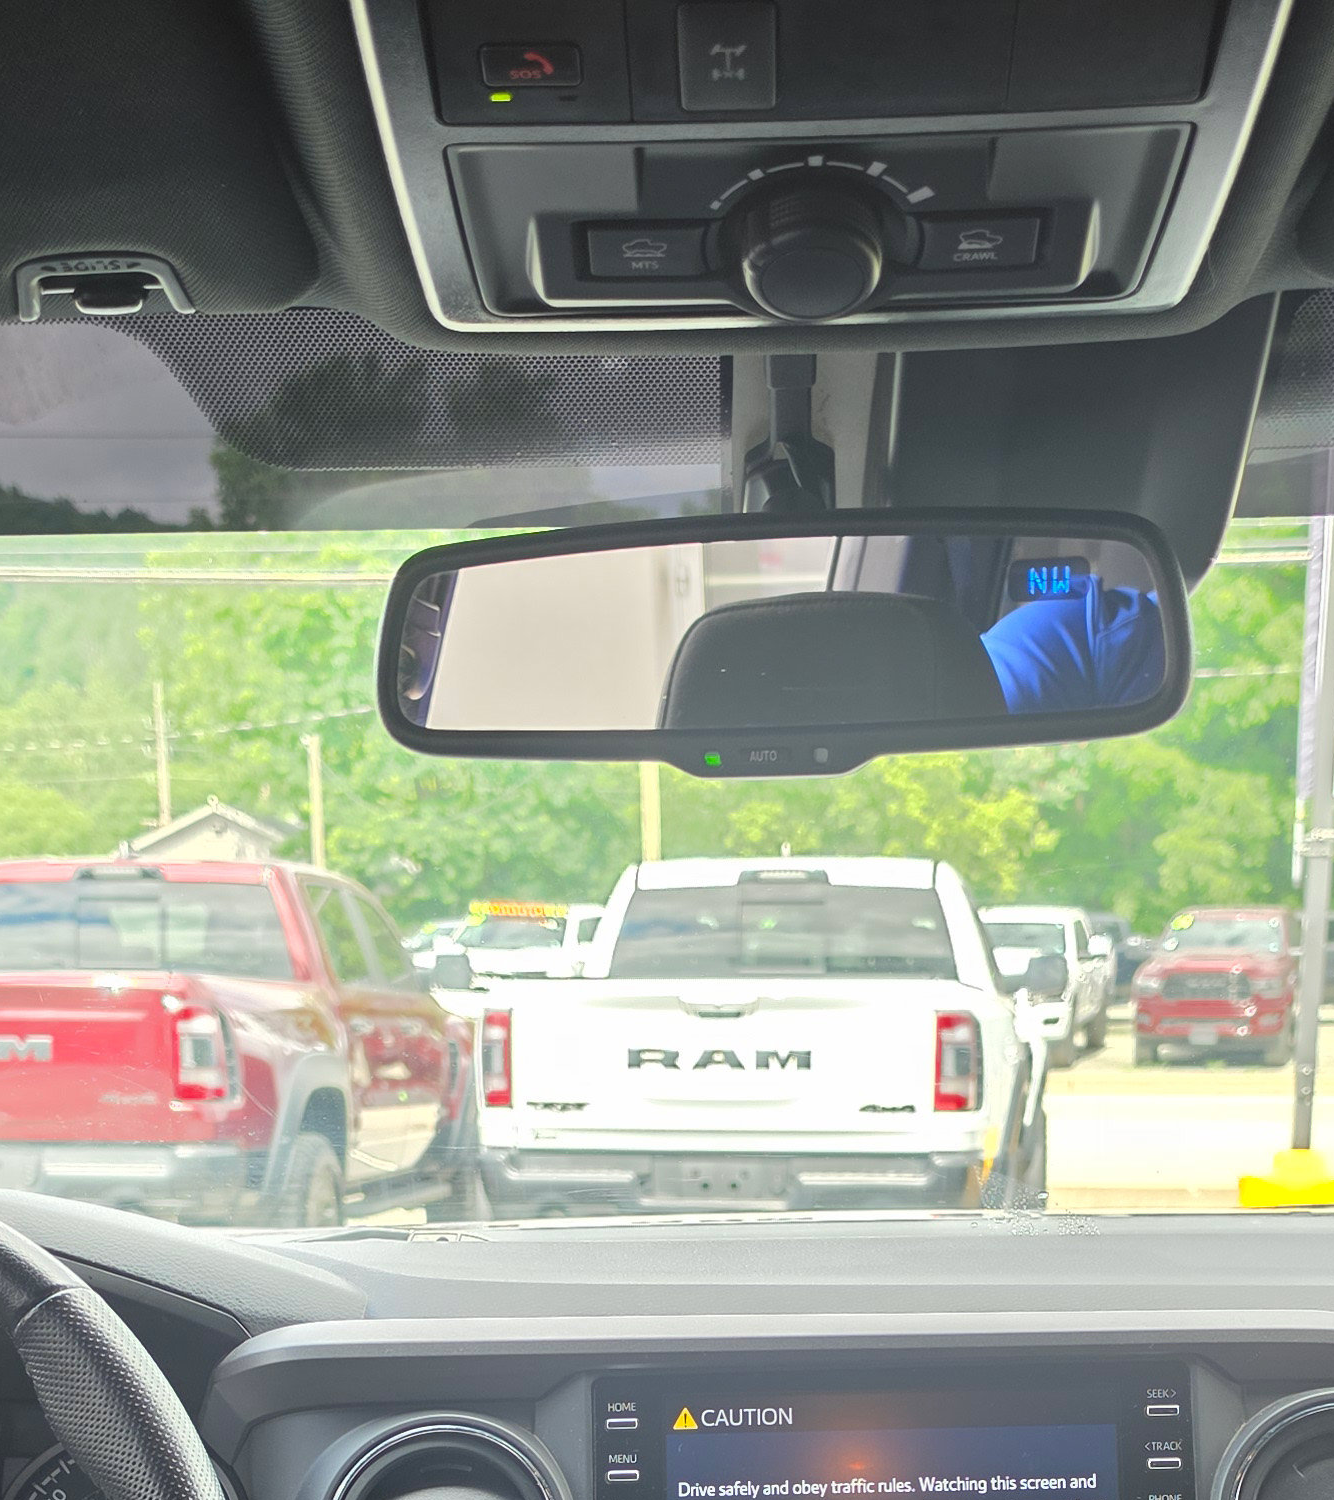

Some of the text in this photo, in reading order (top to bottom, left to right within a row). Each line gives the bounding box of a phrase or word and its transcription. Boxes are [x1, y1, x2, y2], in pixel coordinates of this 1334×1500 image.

[510, 70, 541, 79] SOS
[952, 251, 998, 262] CRAWL
[631, 260, 660, 270] MTS
[1029, 565, 1071, 595] NW
[749, 750, 778, 762] AUTO
[627, 1048, 812, 1071] RAM
[1146, 1389, 1169, 1398] SEEK
[607, 1402, 637, 1412] HOME
[701, 1407, 793, 1427] CAUTION
[1151, 1441, 1182, 1451] TRACK
[608, 1454, 637, 1464] MENU
[678, 1473, 1097, 1498] Drive safely and obey traffic rules. Watching this screen and
